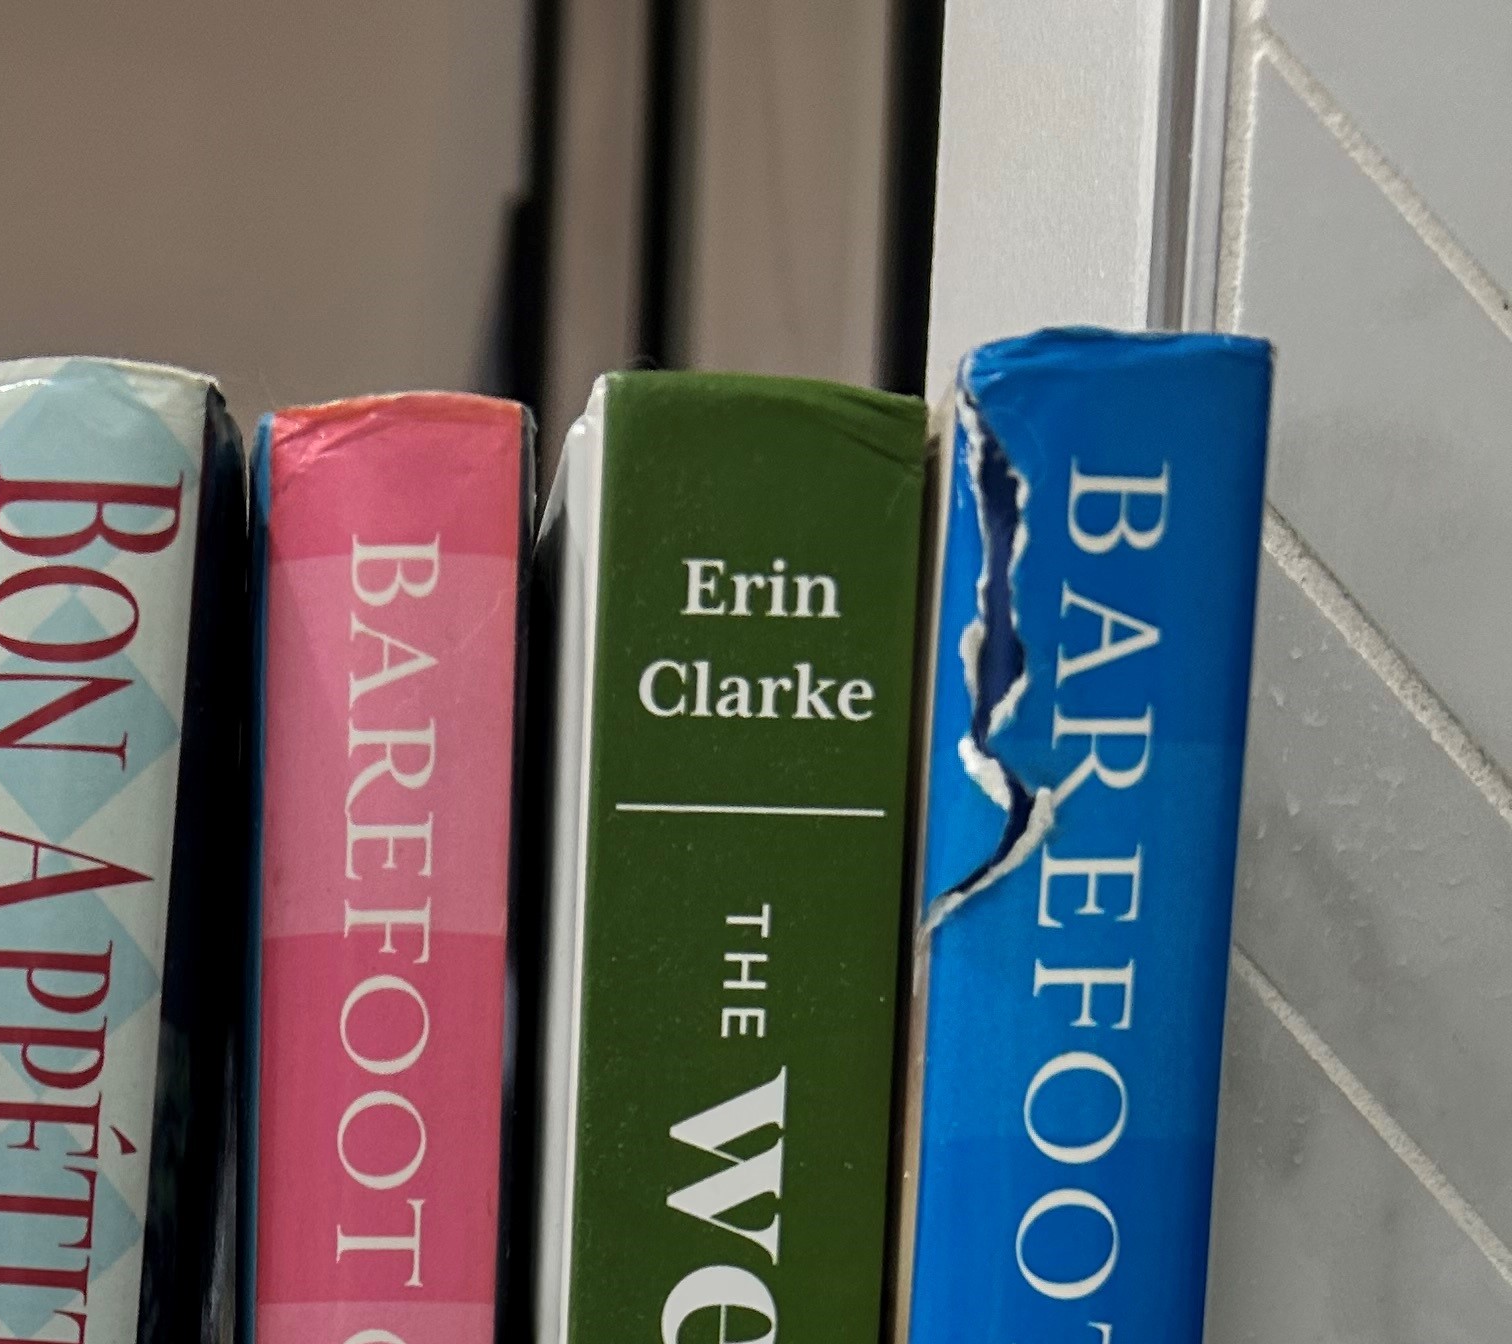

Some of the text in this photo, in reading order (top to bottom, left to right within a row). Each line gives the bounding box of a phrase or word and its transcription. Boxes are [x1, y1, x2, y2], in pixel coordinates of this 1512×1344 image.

[682, 558, 841, 619] Erin
[638, 660, 876, 722] Clarke
[335, 532, 441, 1287] BAREFOOT
[721, 903, 772, 1039] THE
